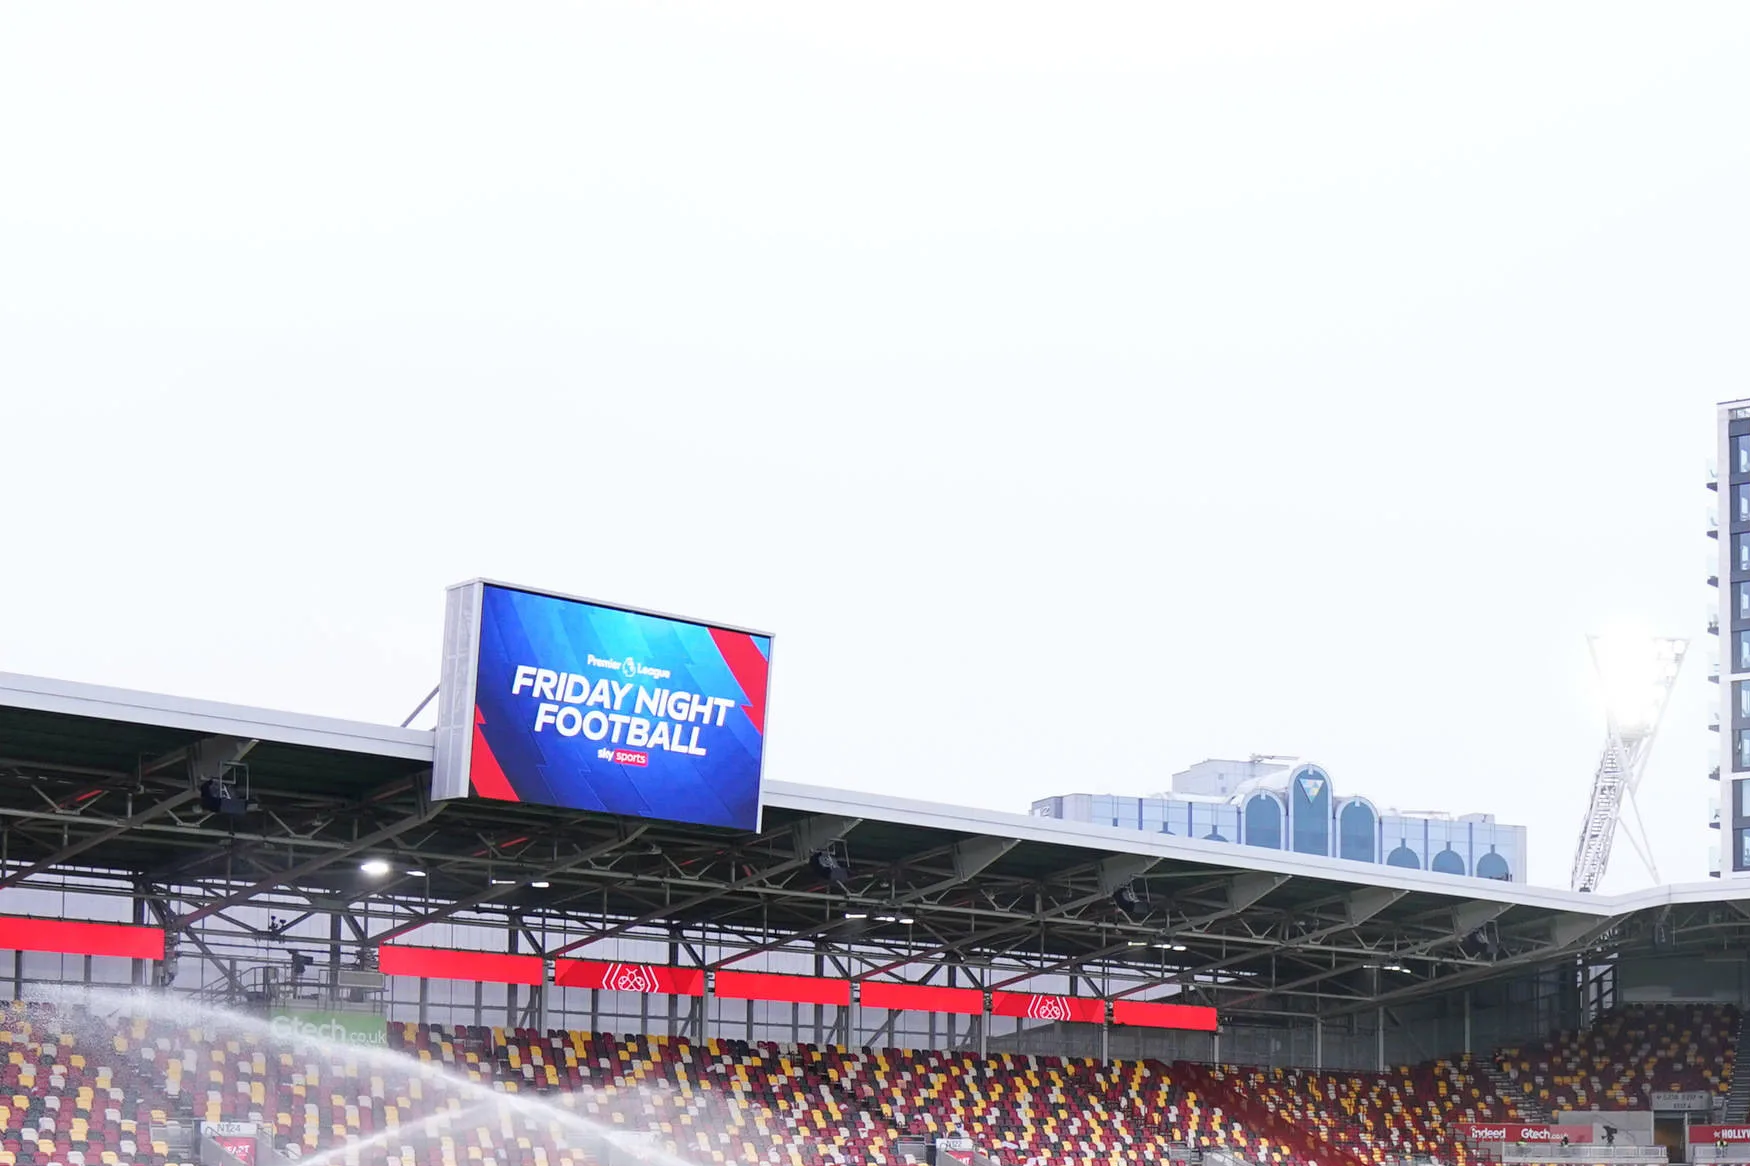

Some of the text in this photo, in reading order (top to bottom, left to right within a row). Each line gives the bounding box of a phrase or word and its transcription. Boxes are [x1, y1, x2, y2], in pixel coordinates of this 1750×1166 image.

[587, 654, 671, 678] Premier League
[512, 665, 735, 727] FRIDAY NIGHT
[533, 702, 707, 757] FOOTBALL
[597, 748, 646, 765] sky sports
[1471, 1126, 1507, 1139] indeed
